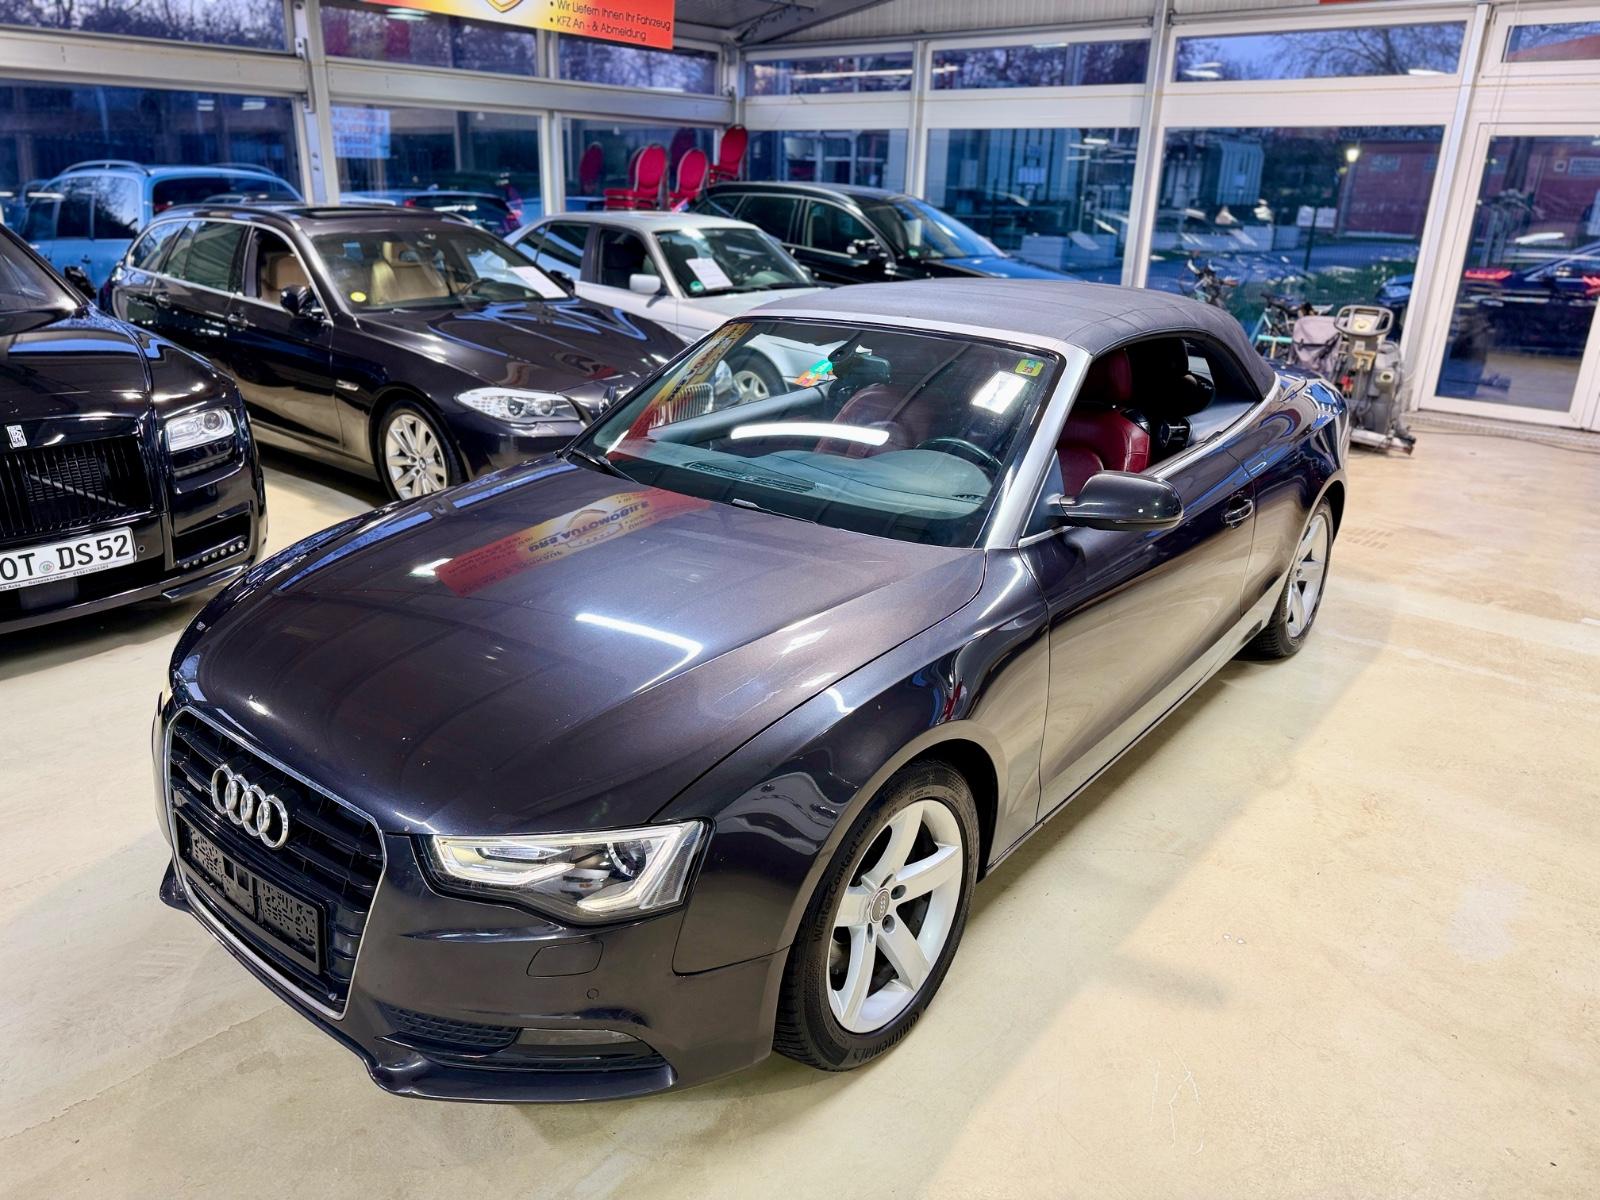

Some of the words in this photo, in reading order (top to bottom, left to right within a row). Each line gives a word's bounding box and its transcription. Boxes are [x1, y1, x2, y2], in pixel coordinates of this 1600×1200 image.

[556, 15, 571, 27] KFZ
[572, 18, 585, 30] An
[591, 21, 599, 32] &
[601, 23, 647, 42] Abmeldung
[557, 0, 571, 11] Wir
[572, 3, 600, 17] Liefern
[601, 8, 625, 21] Ihnen
[625, 12, 636, 23] Ihr
[636, 14, 671, 31] Fahrzeug
